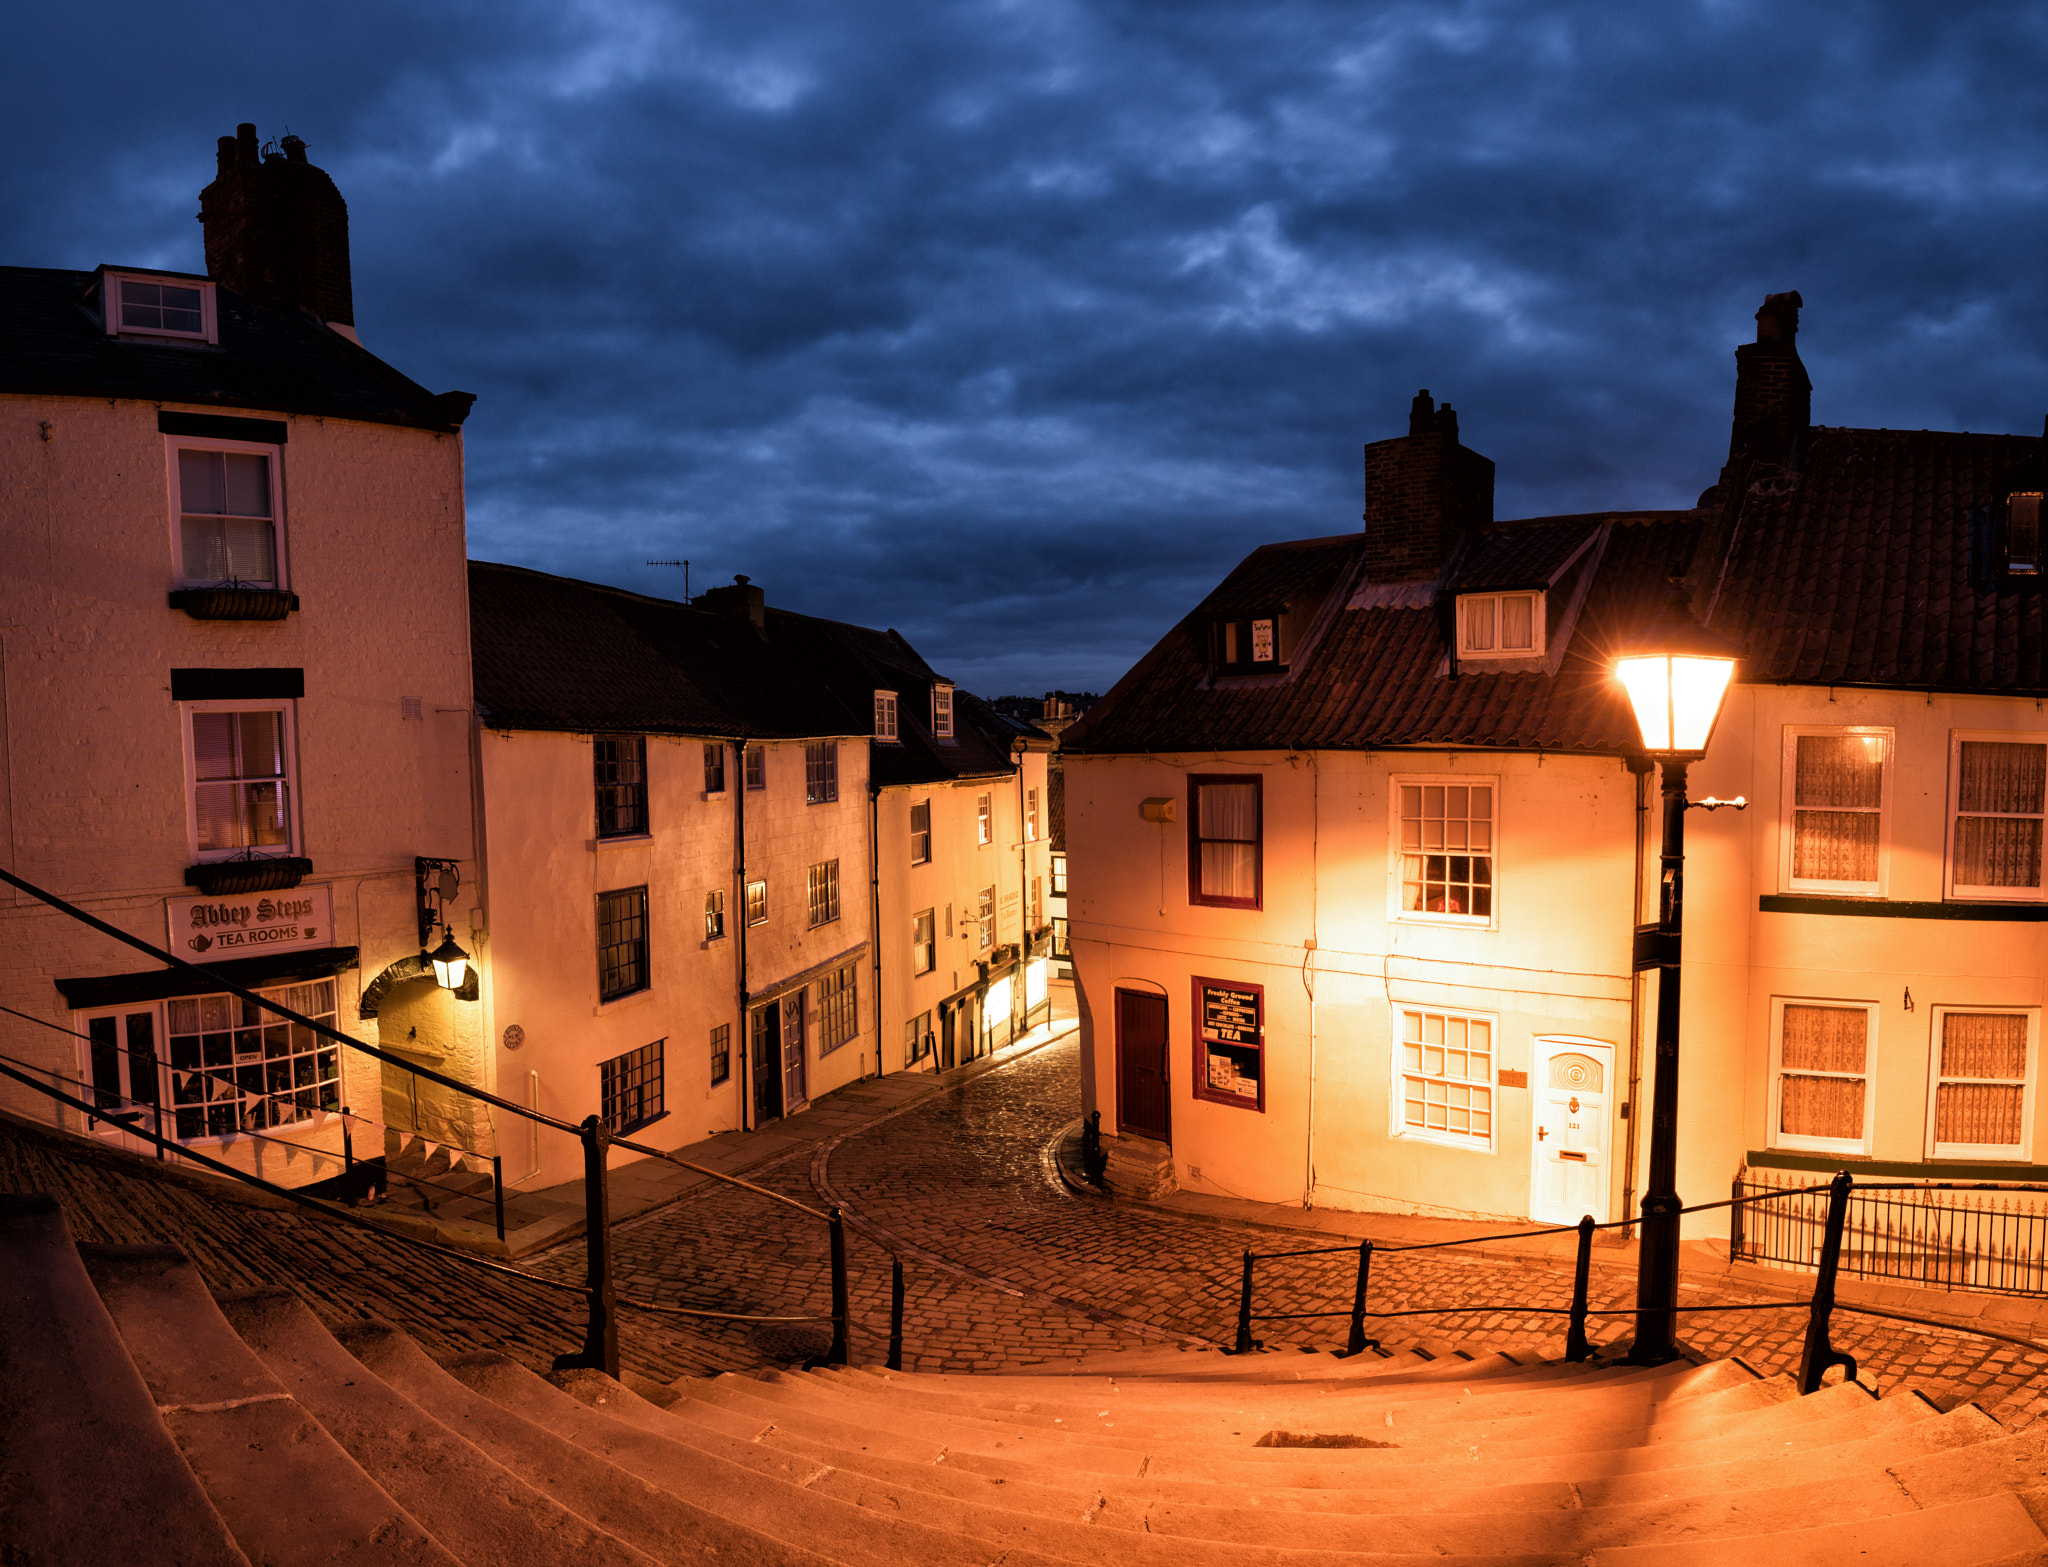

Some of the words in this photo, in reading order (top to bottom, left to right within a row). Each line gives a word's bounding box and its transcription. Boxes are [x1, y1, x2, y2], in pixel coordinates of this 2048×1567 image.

[190, 903, 251, 929] Abbey
[256, 897, 314, 922] Steps
[217, 932, 245, 946] TEA
[249, 926, 298, 943] ROOMS
[1207, 989, 1229, 998] Freshly
[1230, 991, 1254, 1001] Ground
[1220, 997, 1241, 1006] Coffee
[1221, 1029, 1241, 1041] TEA
[239, 1054, 258, 1062] OPEN
[1568, 1122, 1580, 1130] 121
